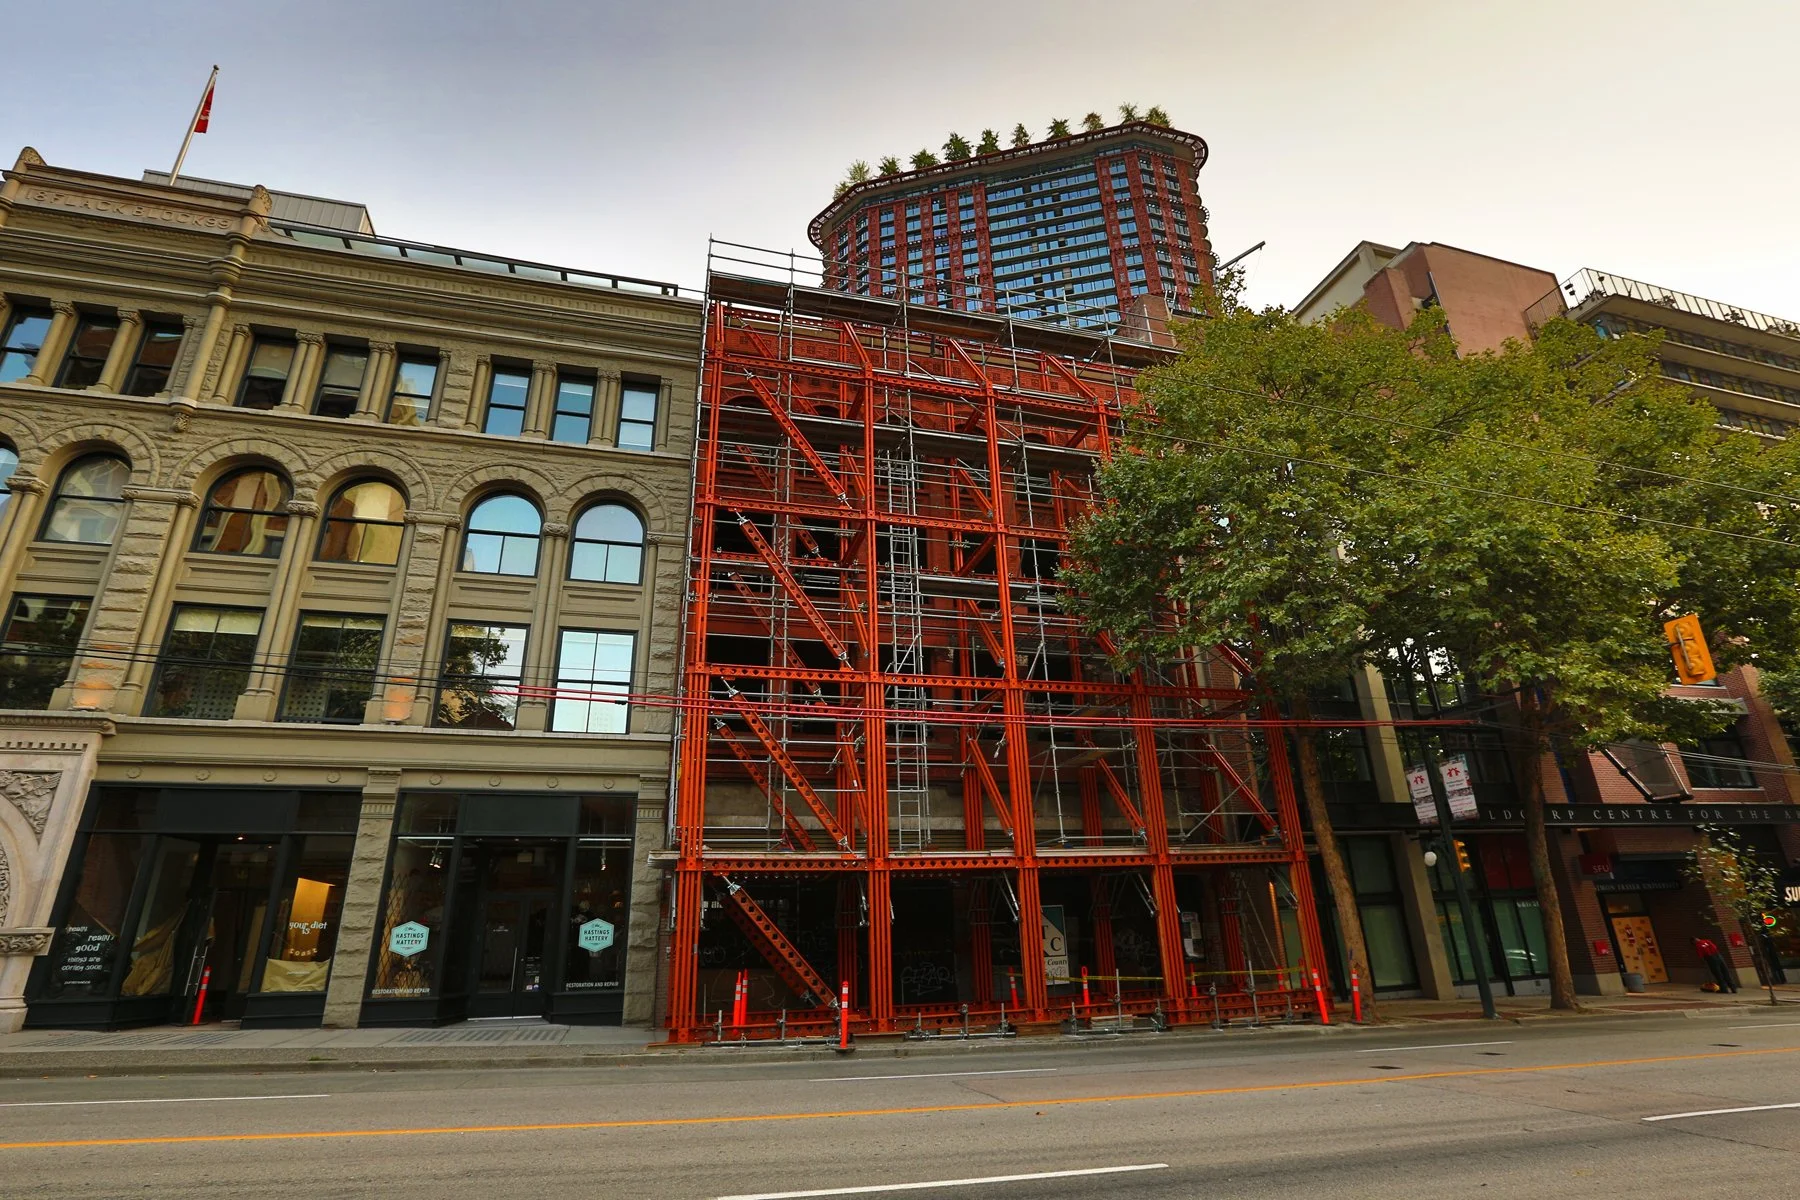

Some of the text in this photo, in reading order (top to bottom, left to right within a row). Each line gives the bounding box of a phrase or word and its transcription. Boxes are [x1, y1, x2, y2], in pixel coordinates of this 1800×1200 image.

[49, 192, 125, 216] FLACK
[132, 206, 203, 226] BLOCK
[1593, 809, 1672, 820] CENTRE
[1688, 809, 1723, 820] FOR
[1736, 809, 1771, 820] THE
[1592, 864, 1610, 873] SFU
[289, 920, 328, 930] your diet
[76, 943, 100, 954] good
[1050, 936, 1062, 952] C
